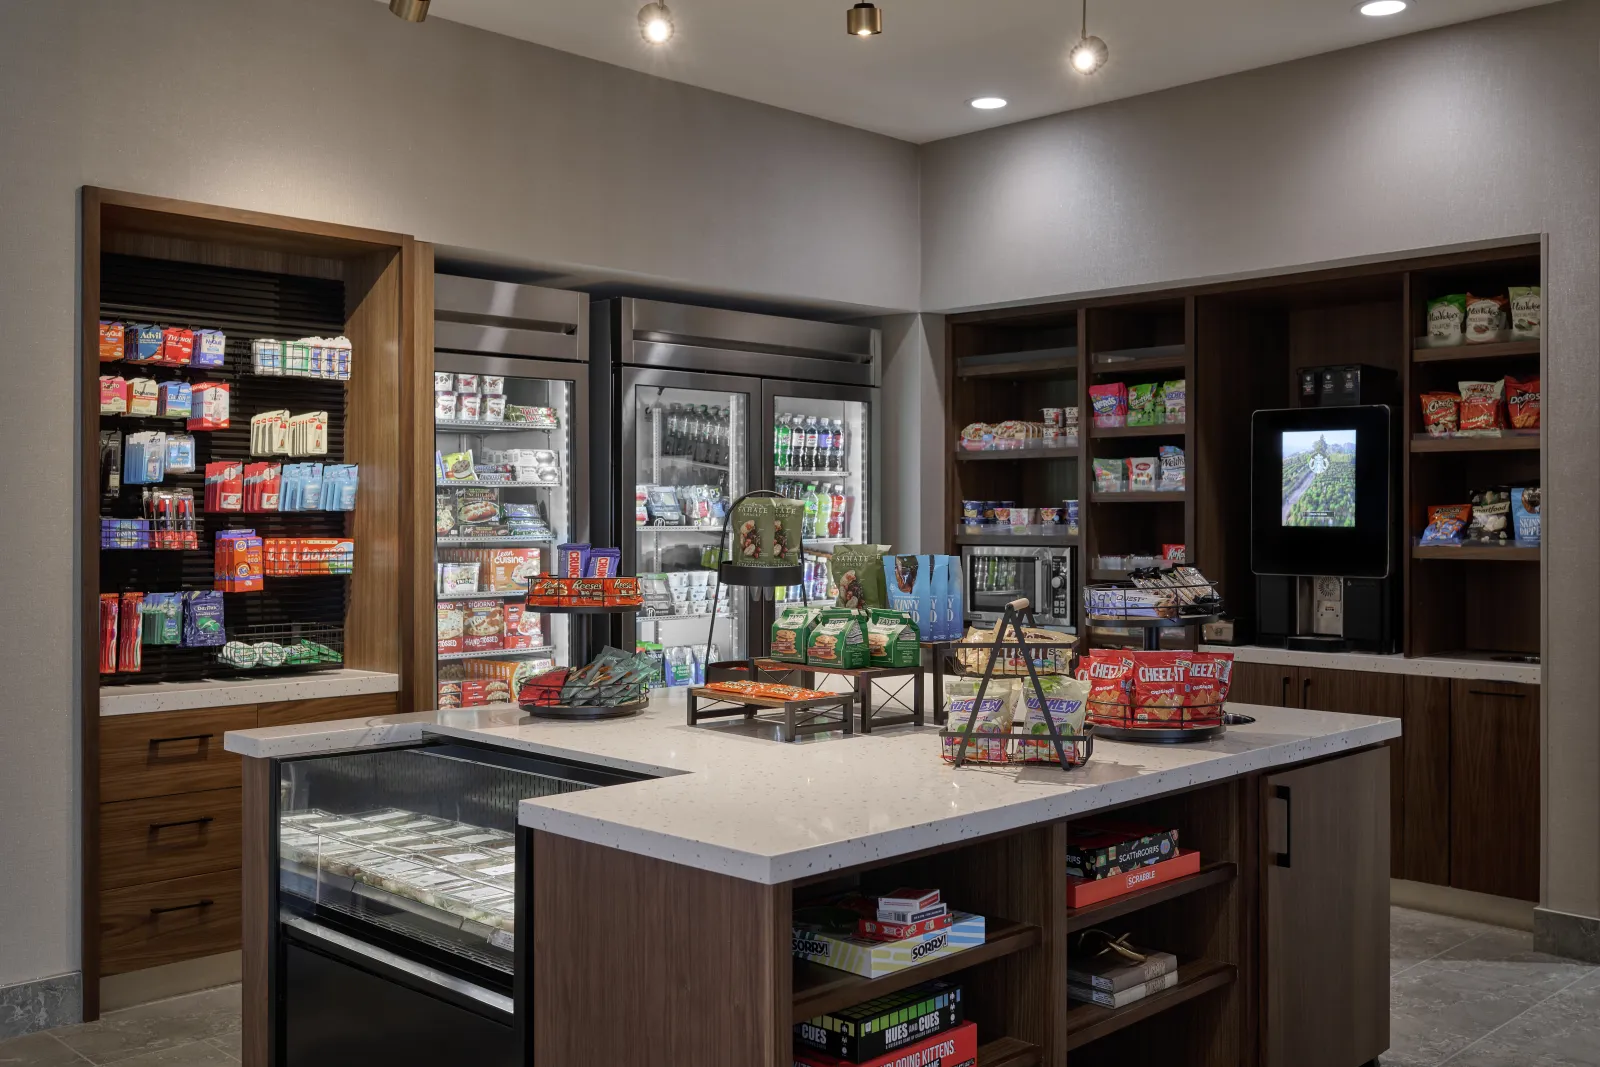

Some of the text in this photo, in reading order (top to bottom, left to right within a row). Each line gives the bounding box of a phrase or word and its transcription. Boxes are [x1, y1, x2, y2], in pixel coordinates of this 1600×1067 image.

[140, 331, 162, 340] Advil
[709, 488, 721, 499] P3
[572, 580, 602, 590] Reese's
[1138, 666, 1185, 682] CHEEZ-IT
[951, 698, 1004, 713] HI-CEW
[1026, 697, 1082, 713] HI-HEW
[1127, 870, 1156, 886] SCRABBLE
[912, 933, 947, 960] SORRY!
[802, 1023, 827, 1045] CUES
[885, 1023, 908, 1045] HUES
[918, 1012, 940, 1032] CUES
[922, 1040, 955, 1063] KITTENS
